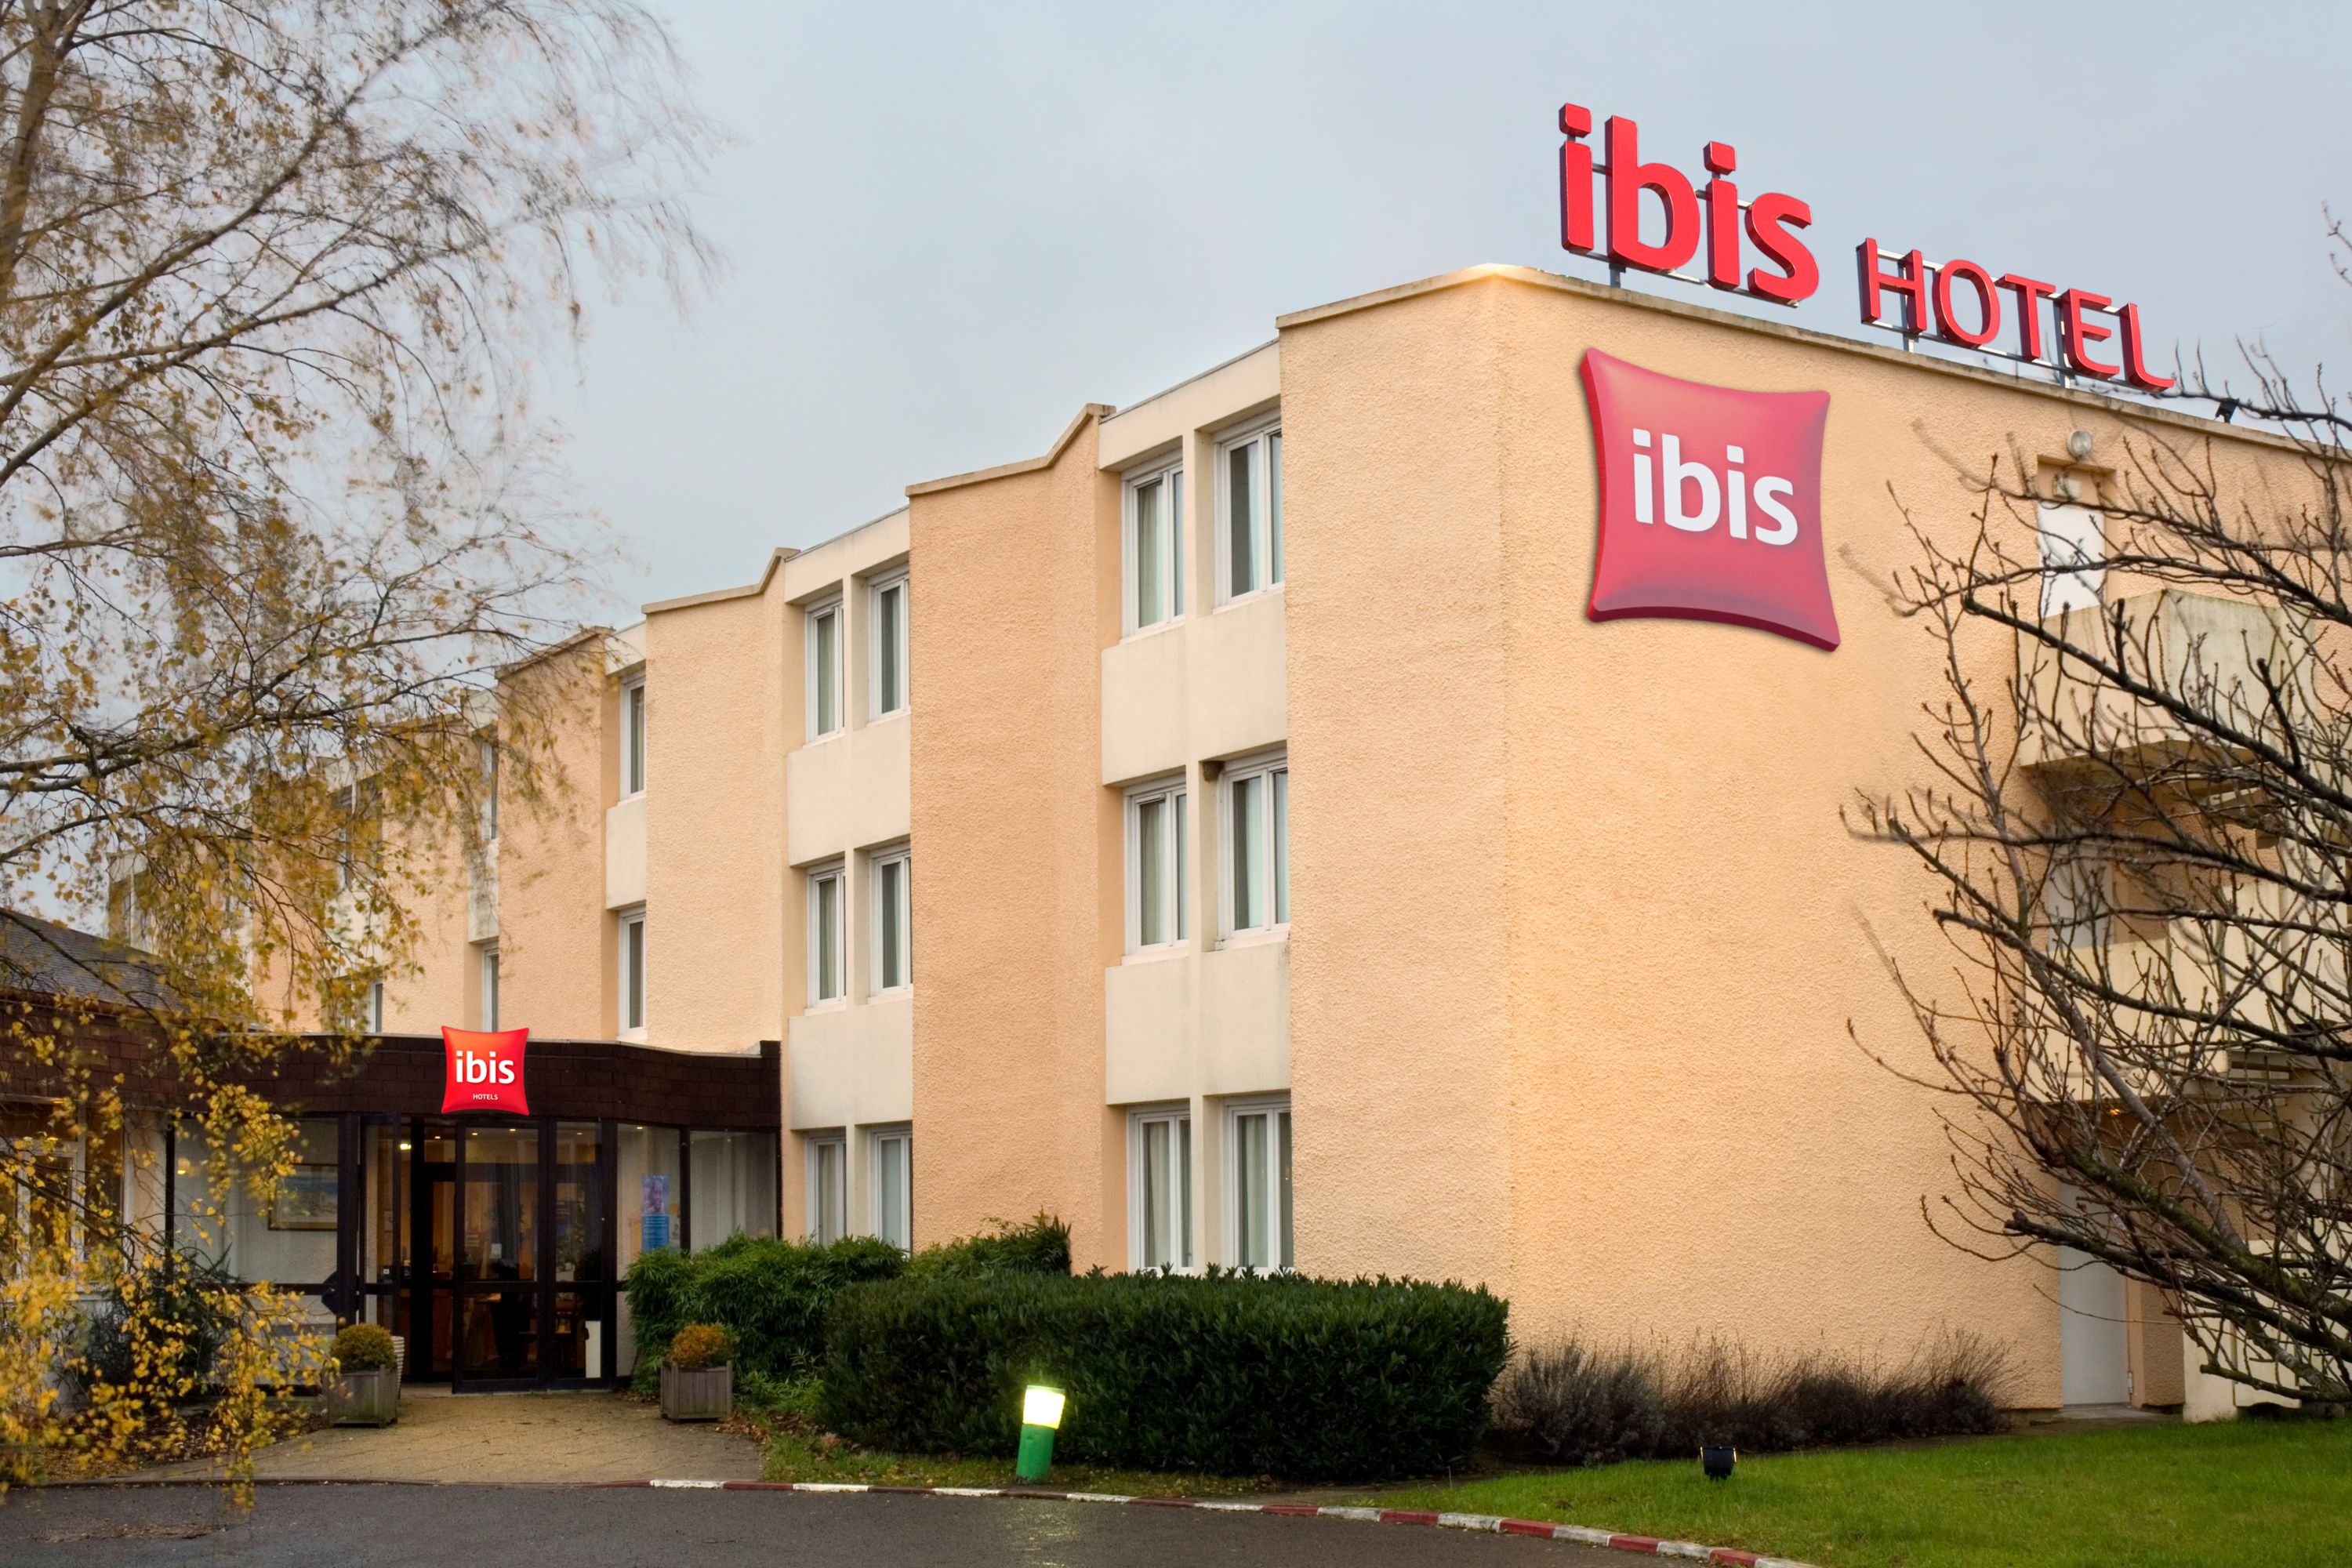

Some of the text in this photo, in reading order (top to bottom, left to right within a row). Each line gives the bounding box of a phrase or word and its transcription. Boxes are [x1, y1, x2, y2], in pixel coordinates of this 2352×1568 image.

[1559, 103, 2174, 394] ibis HOTEL
[1633, 428, 1798, 546] ibis
[456, 1051, 515, 1084] ibis
